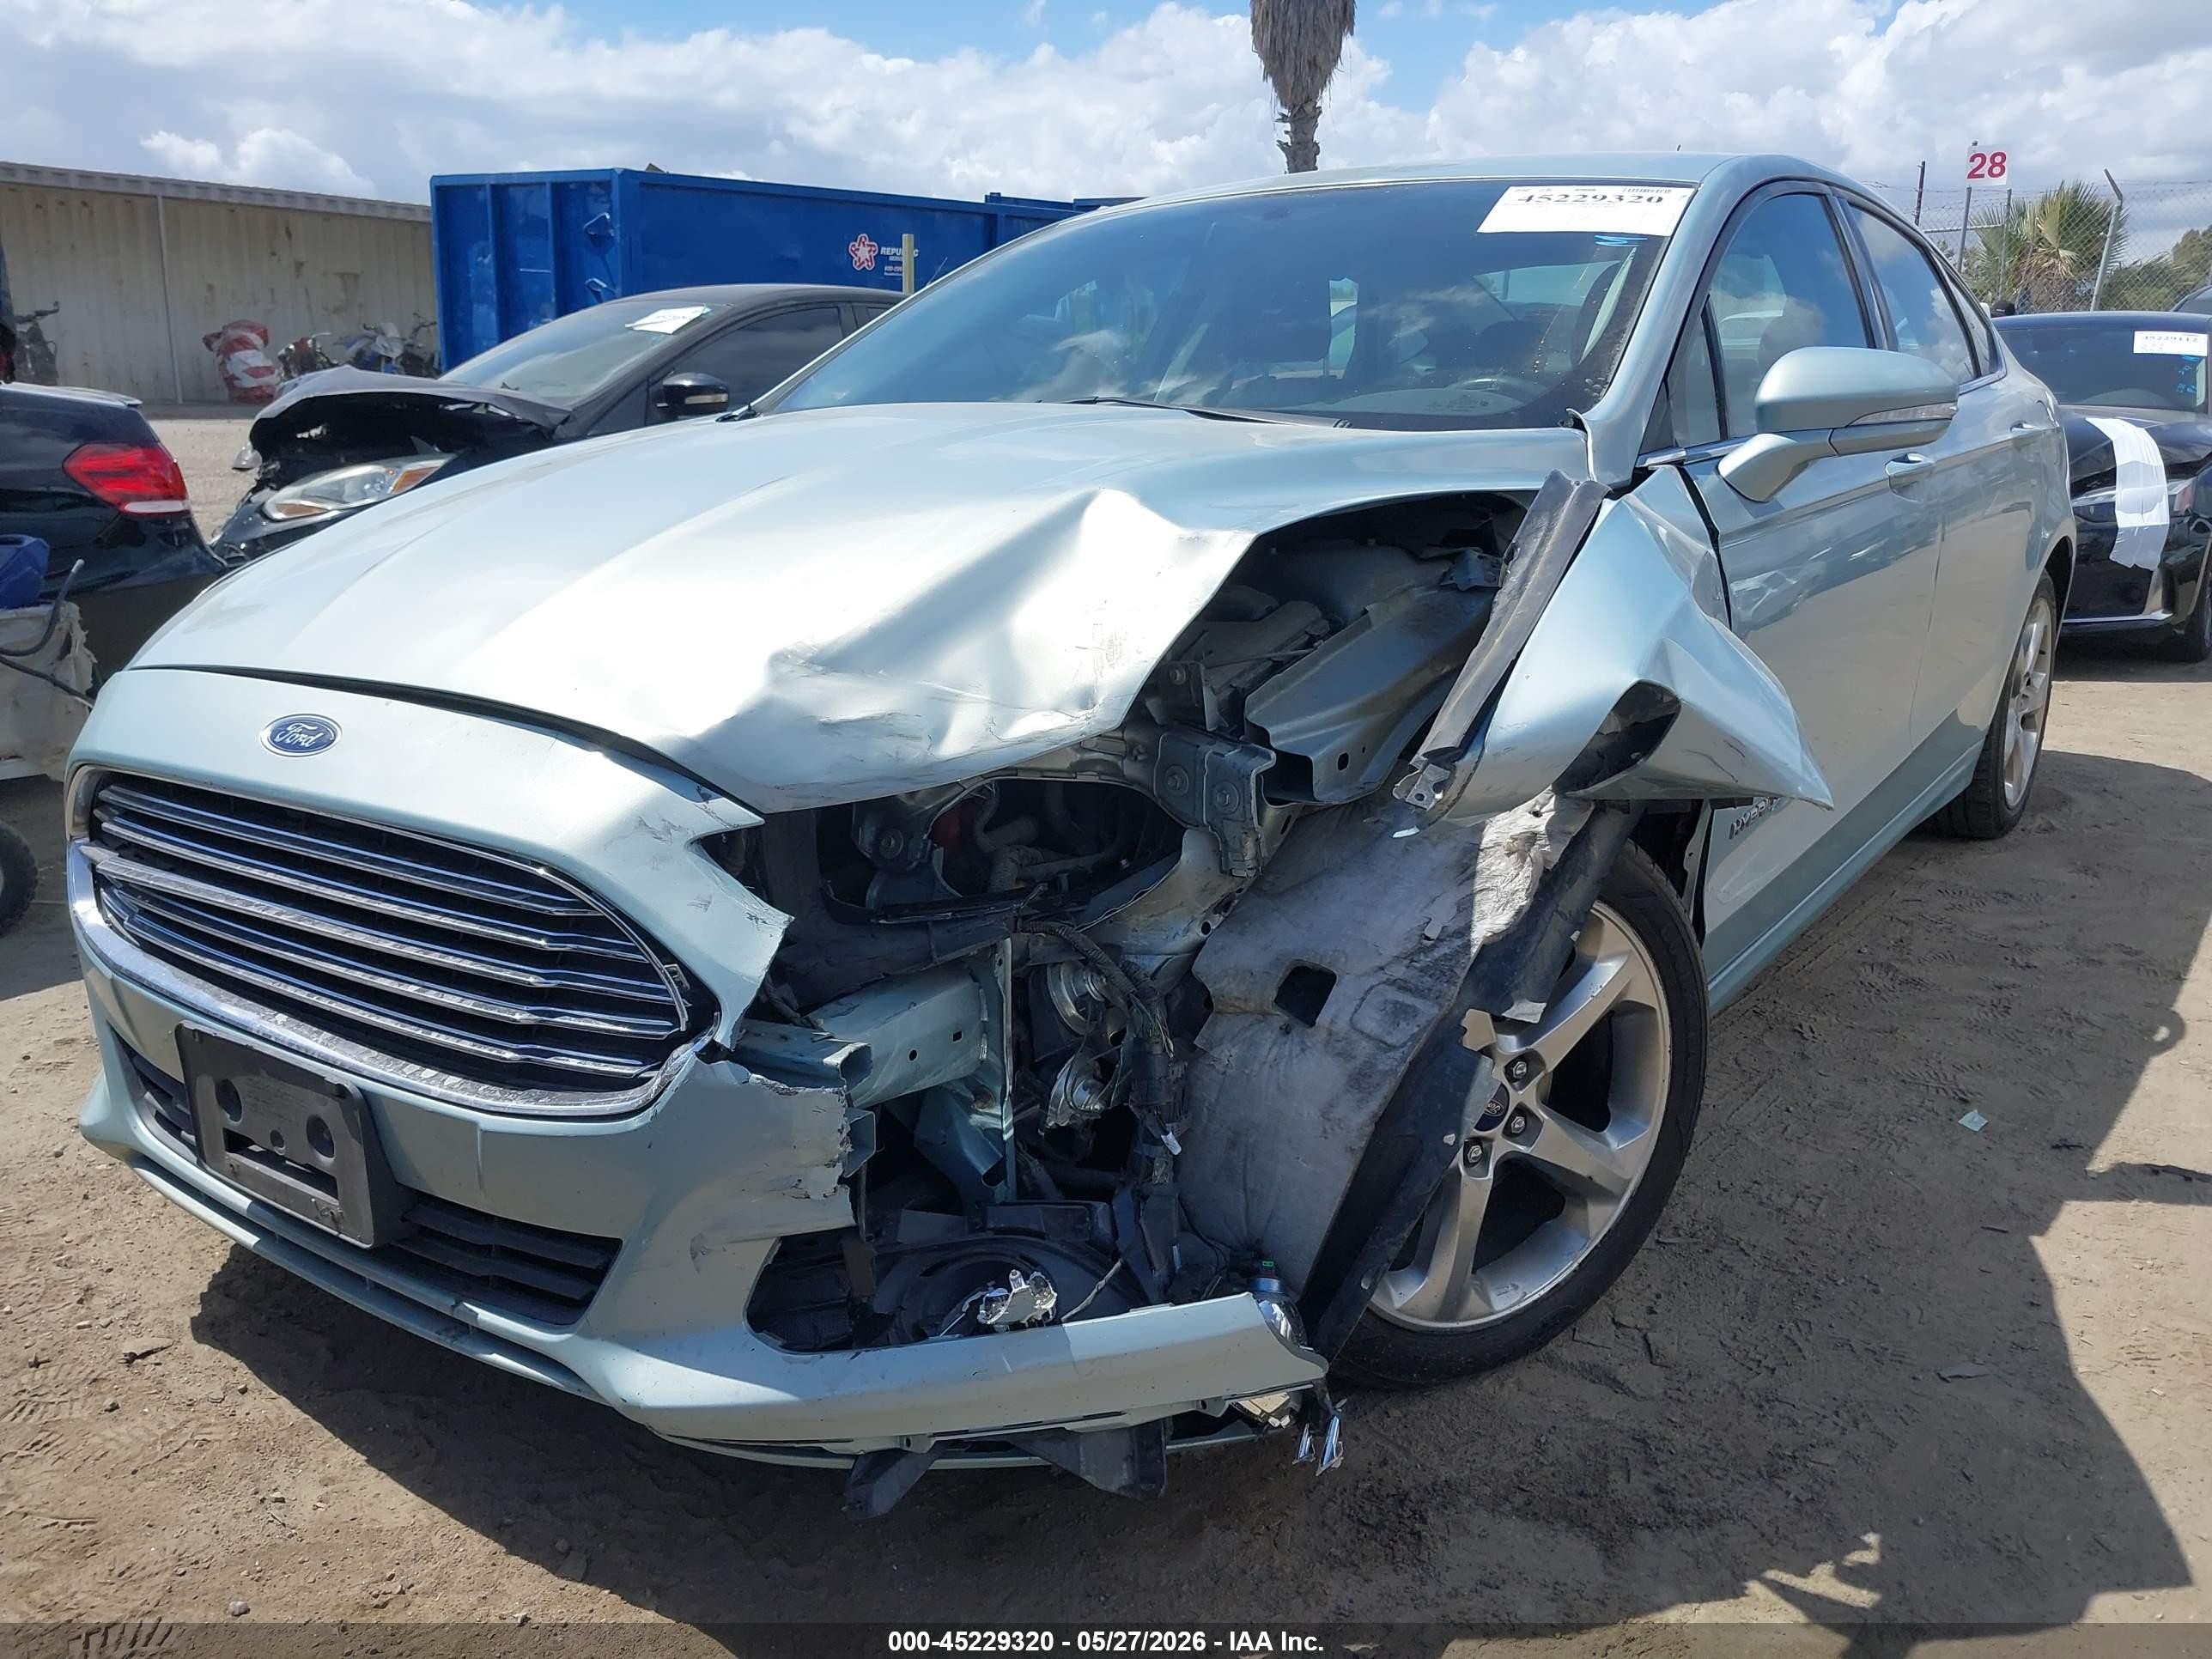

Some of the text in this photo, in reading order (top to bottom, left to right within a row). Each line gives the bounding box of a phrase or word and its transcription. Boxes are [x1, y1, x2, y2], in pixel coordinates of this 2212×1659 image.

[1967, 151, 2007, 179] 28
[1517, 193, 1663, 204] 45229320
[880, 246, 919, 257] REPUC
[274, 722, 325, 747] Ford
